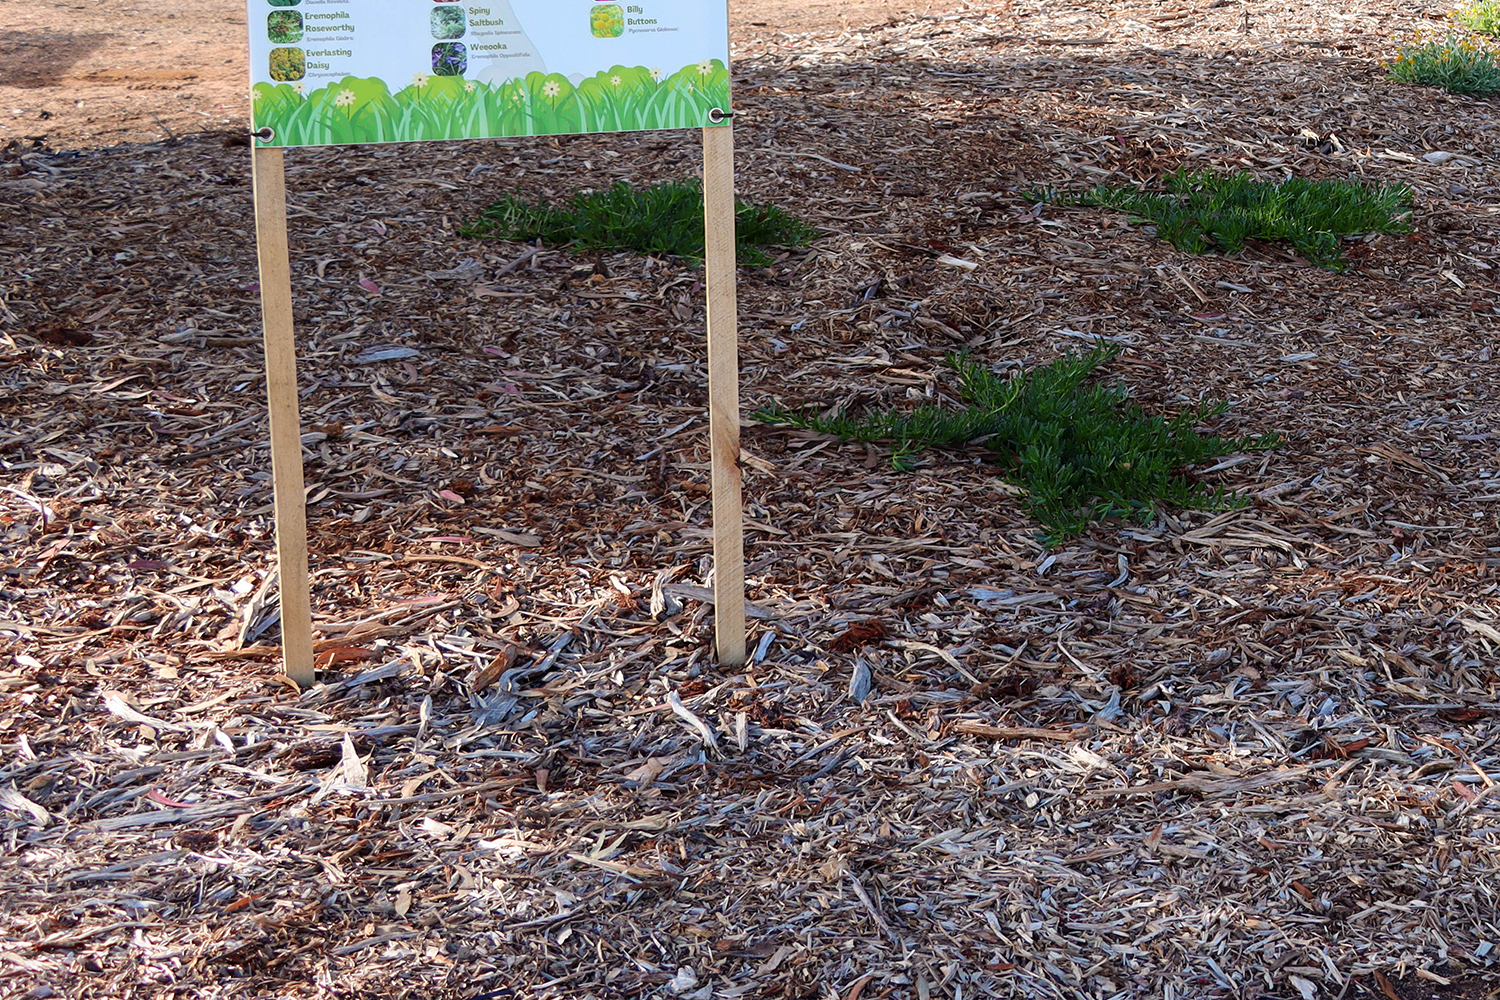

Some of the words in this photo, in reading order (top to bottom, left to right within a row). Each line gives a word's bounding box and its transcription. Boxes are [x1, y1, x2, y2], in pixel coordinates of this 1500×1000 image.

[469, 7, 490, 16] Spiny
[627, 5, 643, 14] Billy
[305, 11, 350, 21] Eremophila
[469, 18, 503, 27] Saltbush
[305, 24, 355, 33] Roseworthy
[306, 48, 352, 58] Everlasting
[307, 61, 330, 71] Daisy
